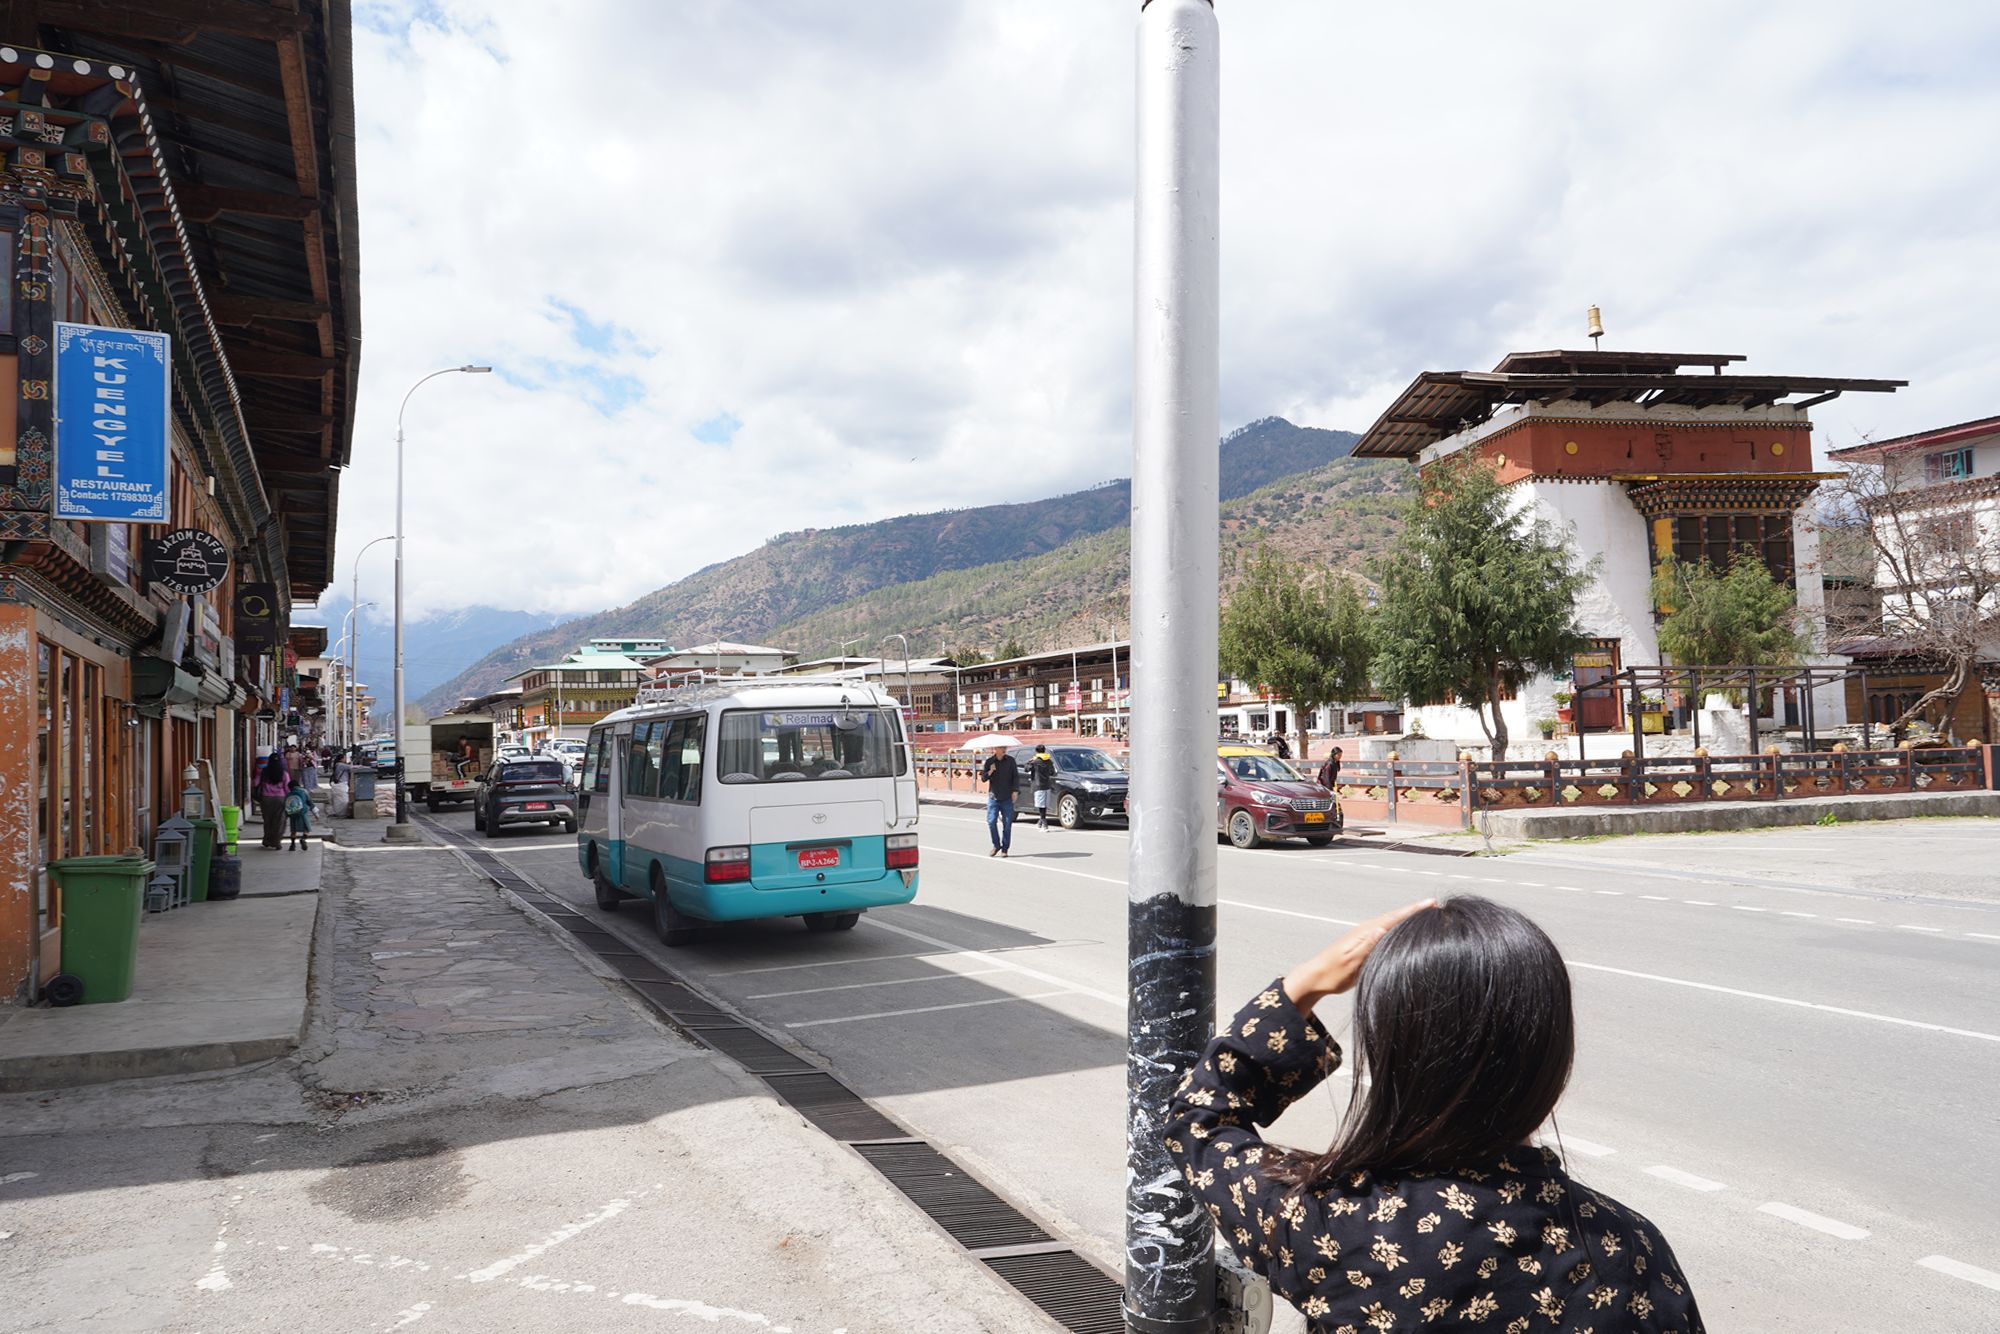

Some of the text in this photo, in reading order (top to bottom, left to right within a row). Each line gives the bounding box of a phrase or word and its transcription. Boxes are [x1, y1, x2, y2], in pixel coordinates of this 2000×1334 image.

[92, 356, 128, 478] KUENGYEL
[70, 489, 108, 500] Contact:
[71, 479, 152, 492] RESTAURANT
[158, 530, 224, 555] JAZOM CAFE
